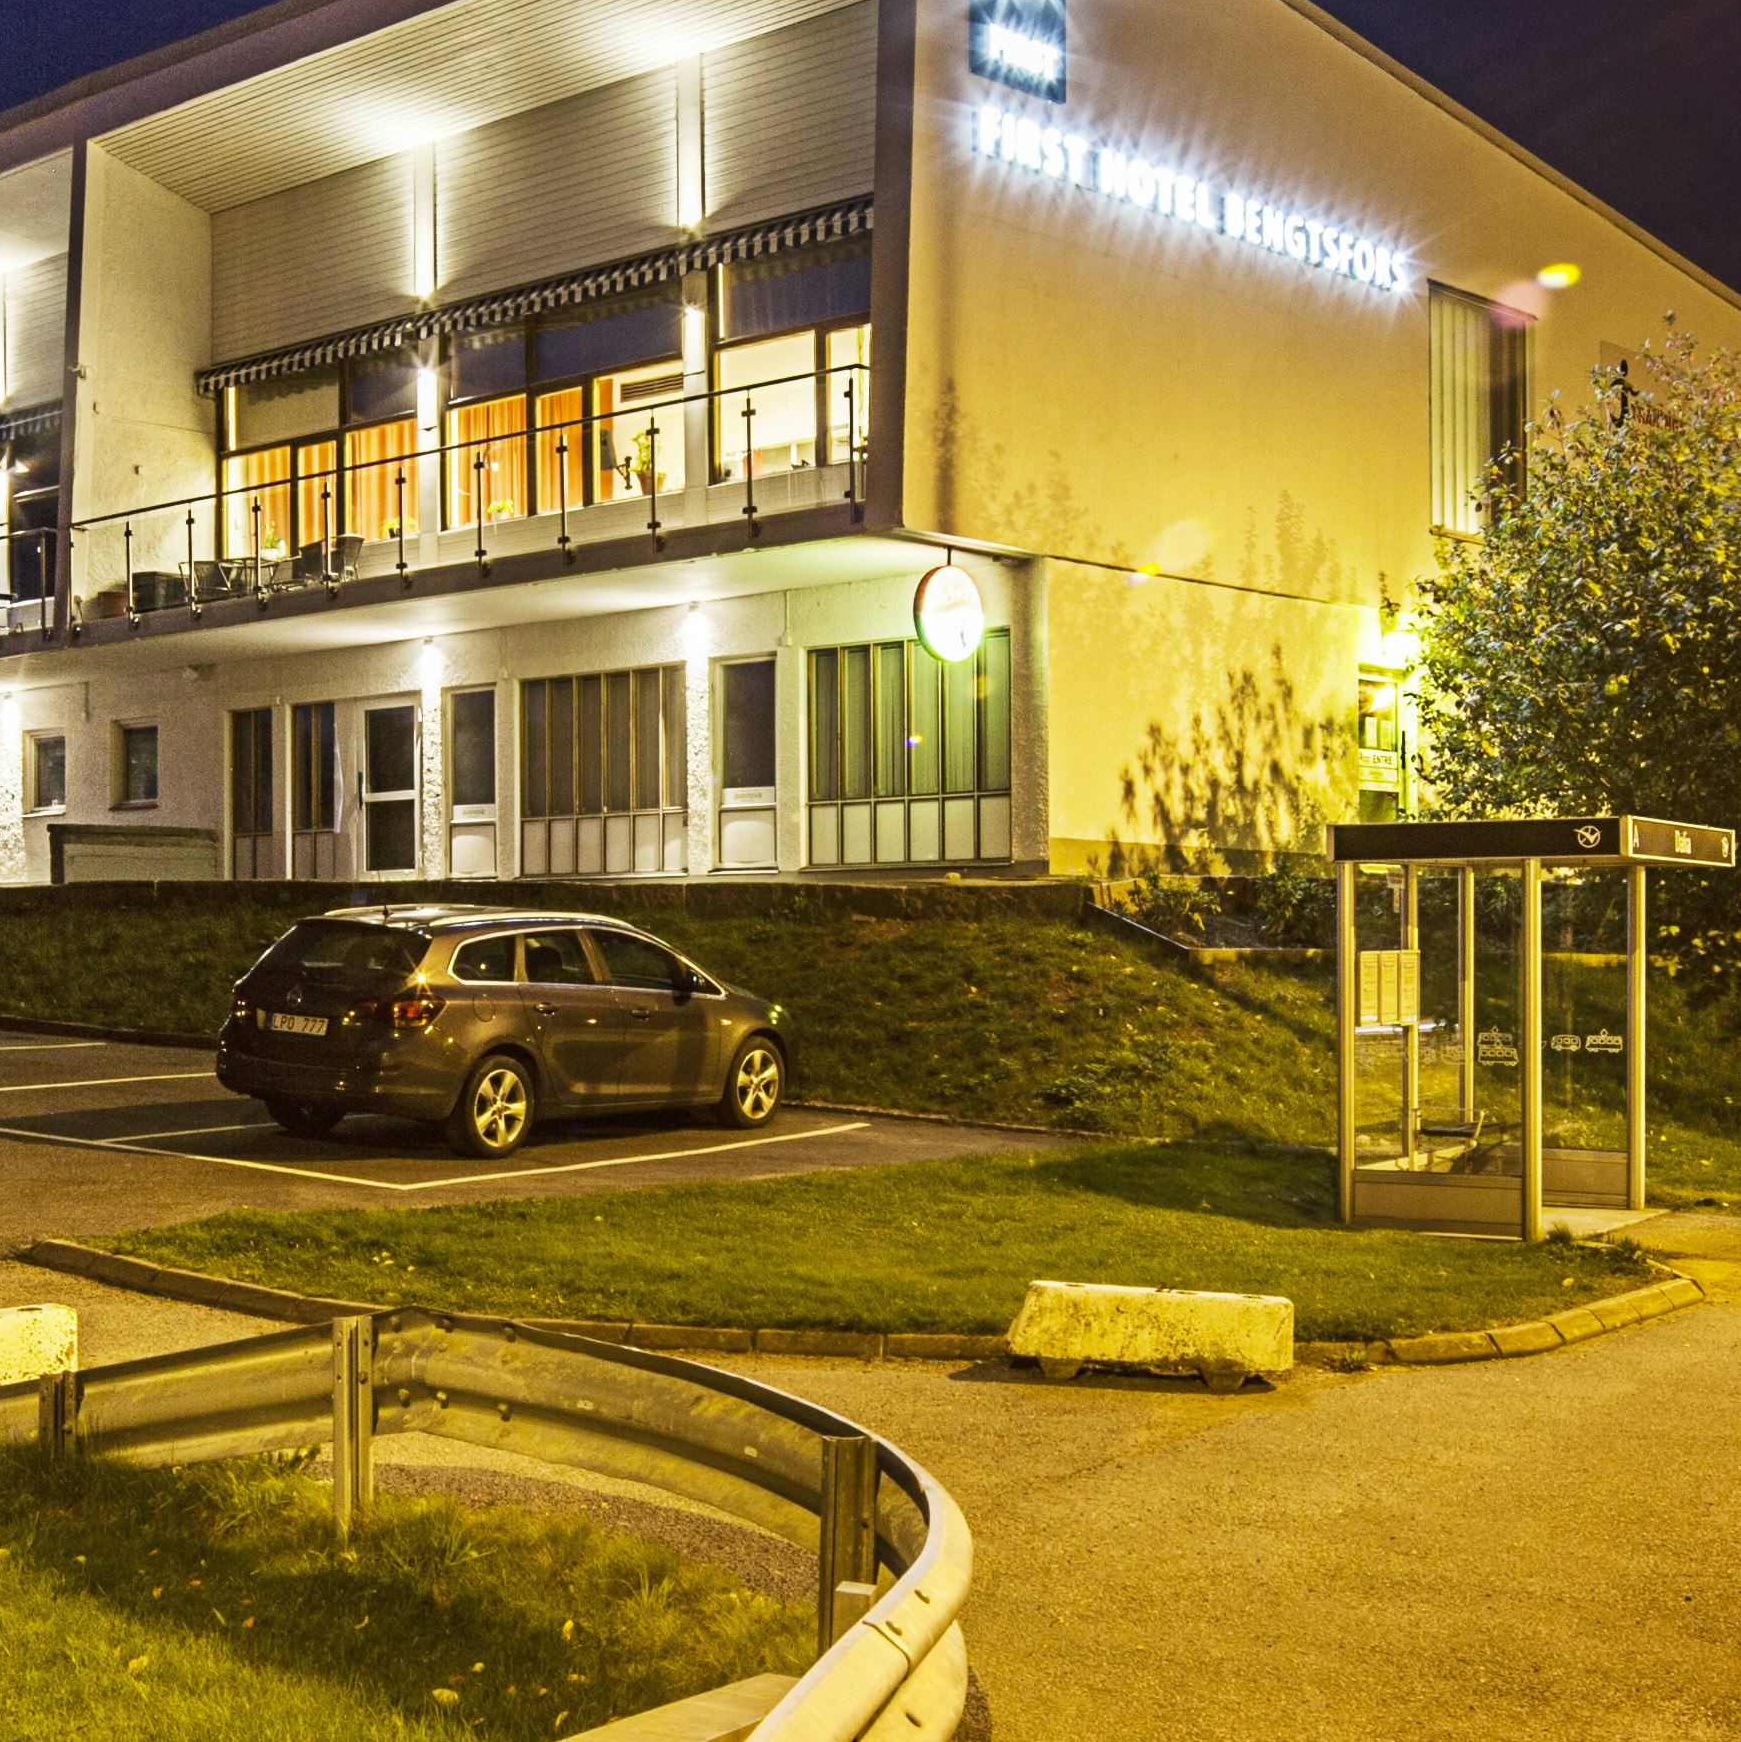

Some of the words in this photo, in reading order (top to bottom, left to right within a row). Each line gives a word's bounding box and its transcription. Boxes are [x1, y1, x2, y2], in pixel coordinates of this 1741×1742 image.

[980, 106, 1087, 182] FIRST
[1100, 148, 1215, 229] HOTEL
[1225, 193, 1407, 292] BENGTSFORS
[301, 1017, 325, 1033] 777
